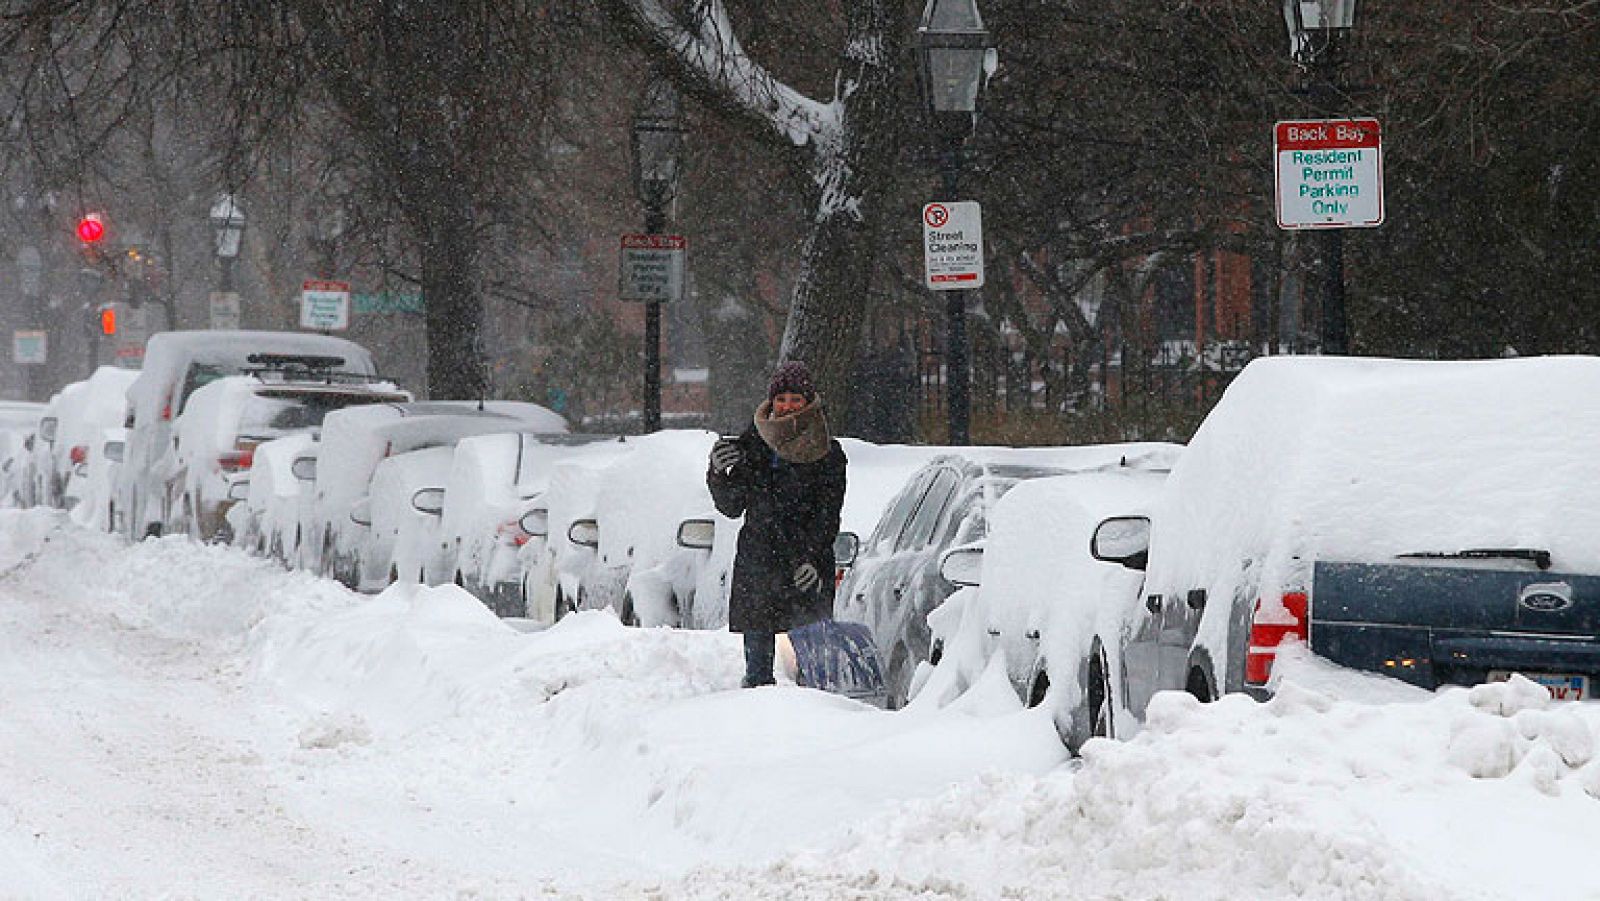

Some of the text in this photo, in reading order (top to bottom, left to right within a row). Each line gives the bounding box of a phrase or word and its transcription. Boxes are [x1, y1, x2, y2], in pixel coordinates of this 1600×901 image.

[1287, 125, 1365, 143] Back Bay
[1293, 150, 1362, 165] Resident
[1302, 166, 1353, 182] Permit
[1299, 183, 1359, 198] Parking
[1312, 200, 1349, 215] Only
[928, 231, 963, 243] Street
[928, 242, 978, 253] Cleaning
